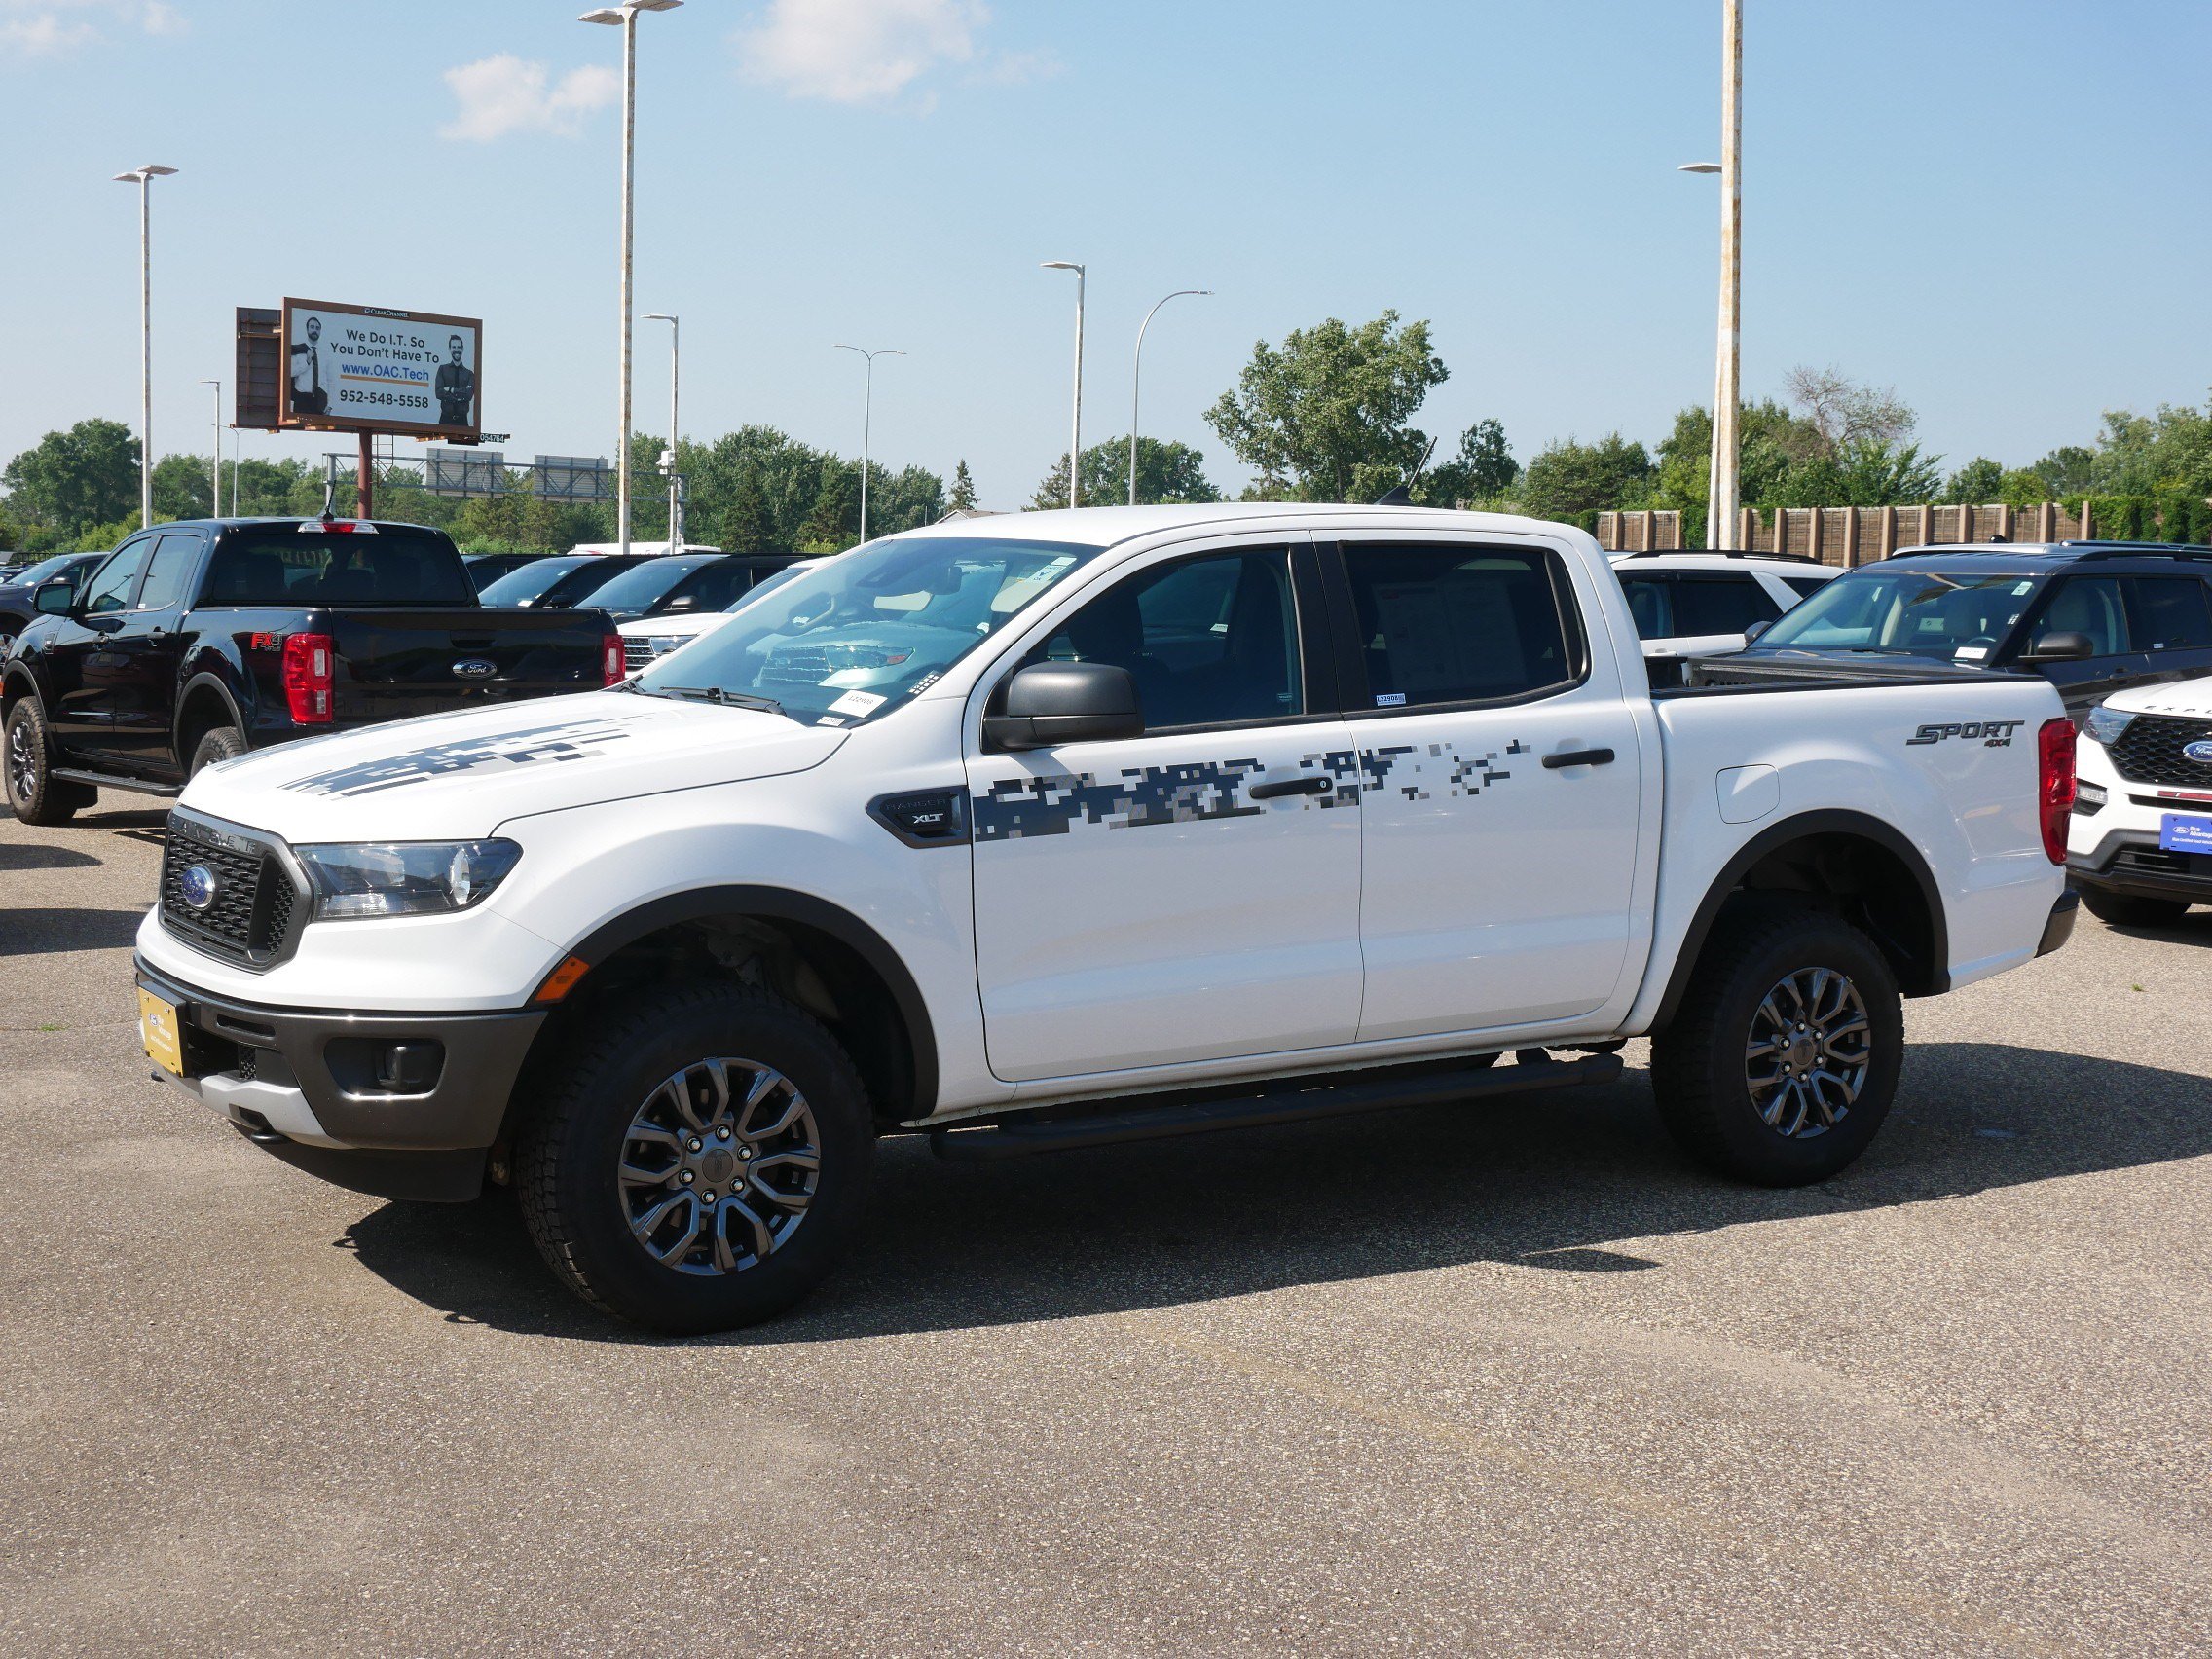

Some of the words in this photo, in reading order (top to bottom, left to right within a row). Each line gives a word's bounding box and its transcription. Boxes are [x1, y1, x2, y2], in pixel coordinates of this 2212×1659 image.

[346, 329, 366, 342] We
[369, 331, 387, 344] Do
[389, 333, 407, 347] I.T.
[410, 336, 425, 349] So
[330, 342, 354, 355] You
[357, 345, 389, 359] Don't
[392, 349, 422, 362] Have
[424, 351, 440, 363] To
[341, 364, 429, 382] www.OAC.Tech
[340, 389, 429, 409] 952-548-5558
[250, 631, 283, 650] FX4
[1905, 719, 2026, 746] SPORT
[886, 798, 945, 810] RANGER
[911, 813, 944, 824] XLT
